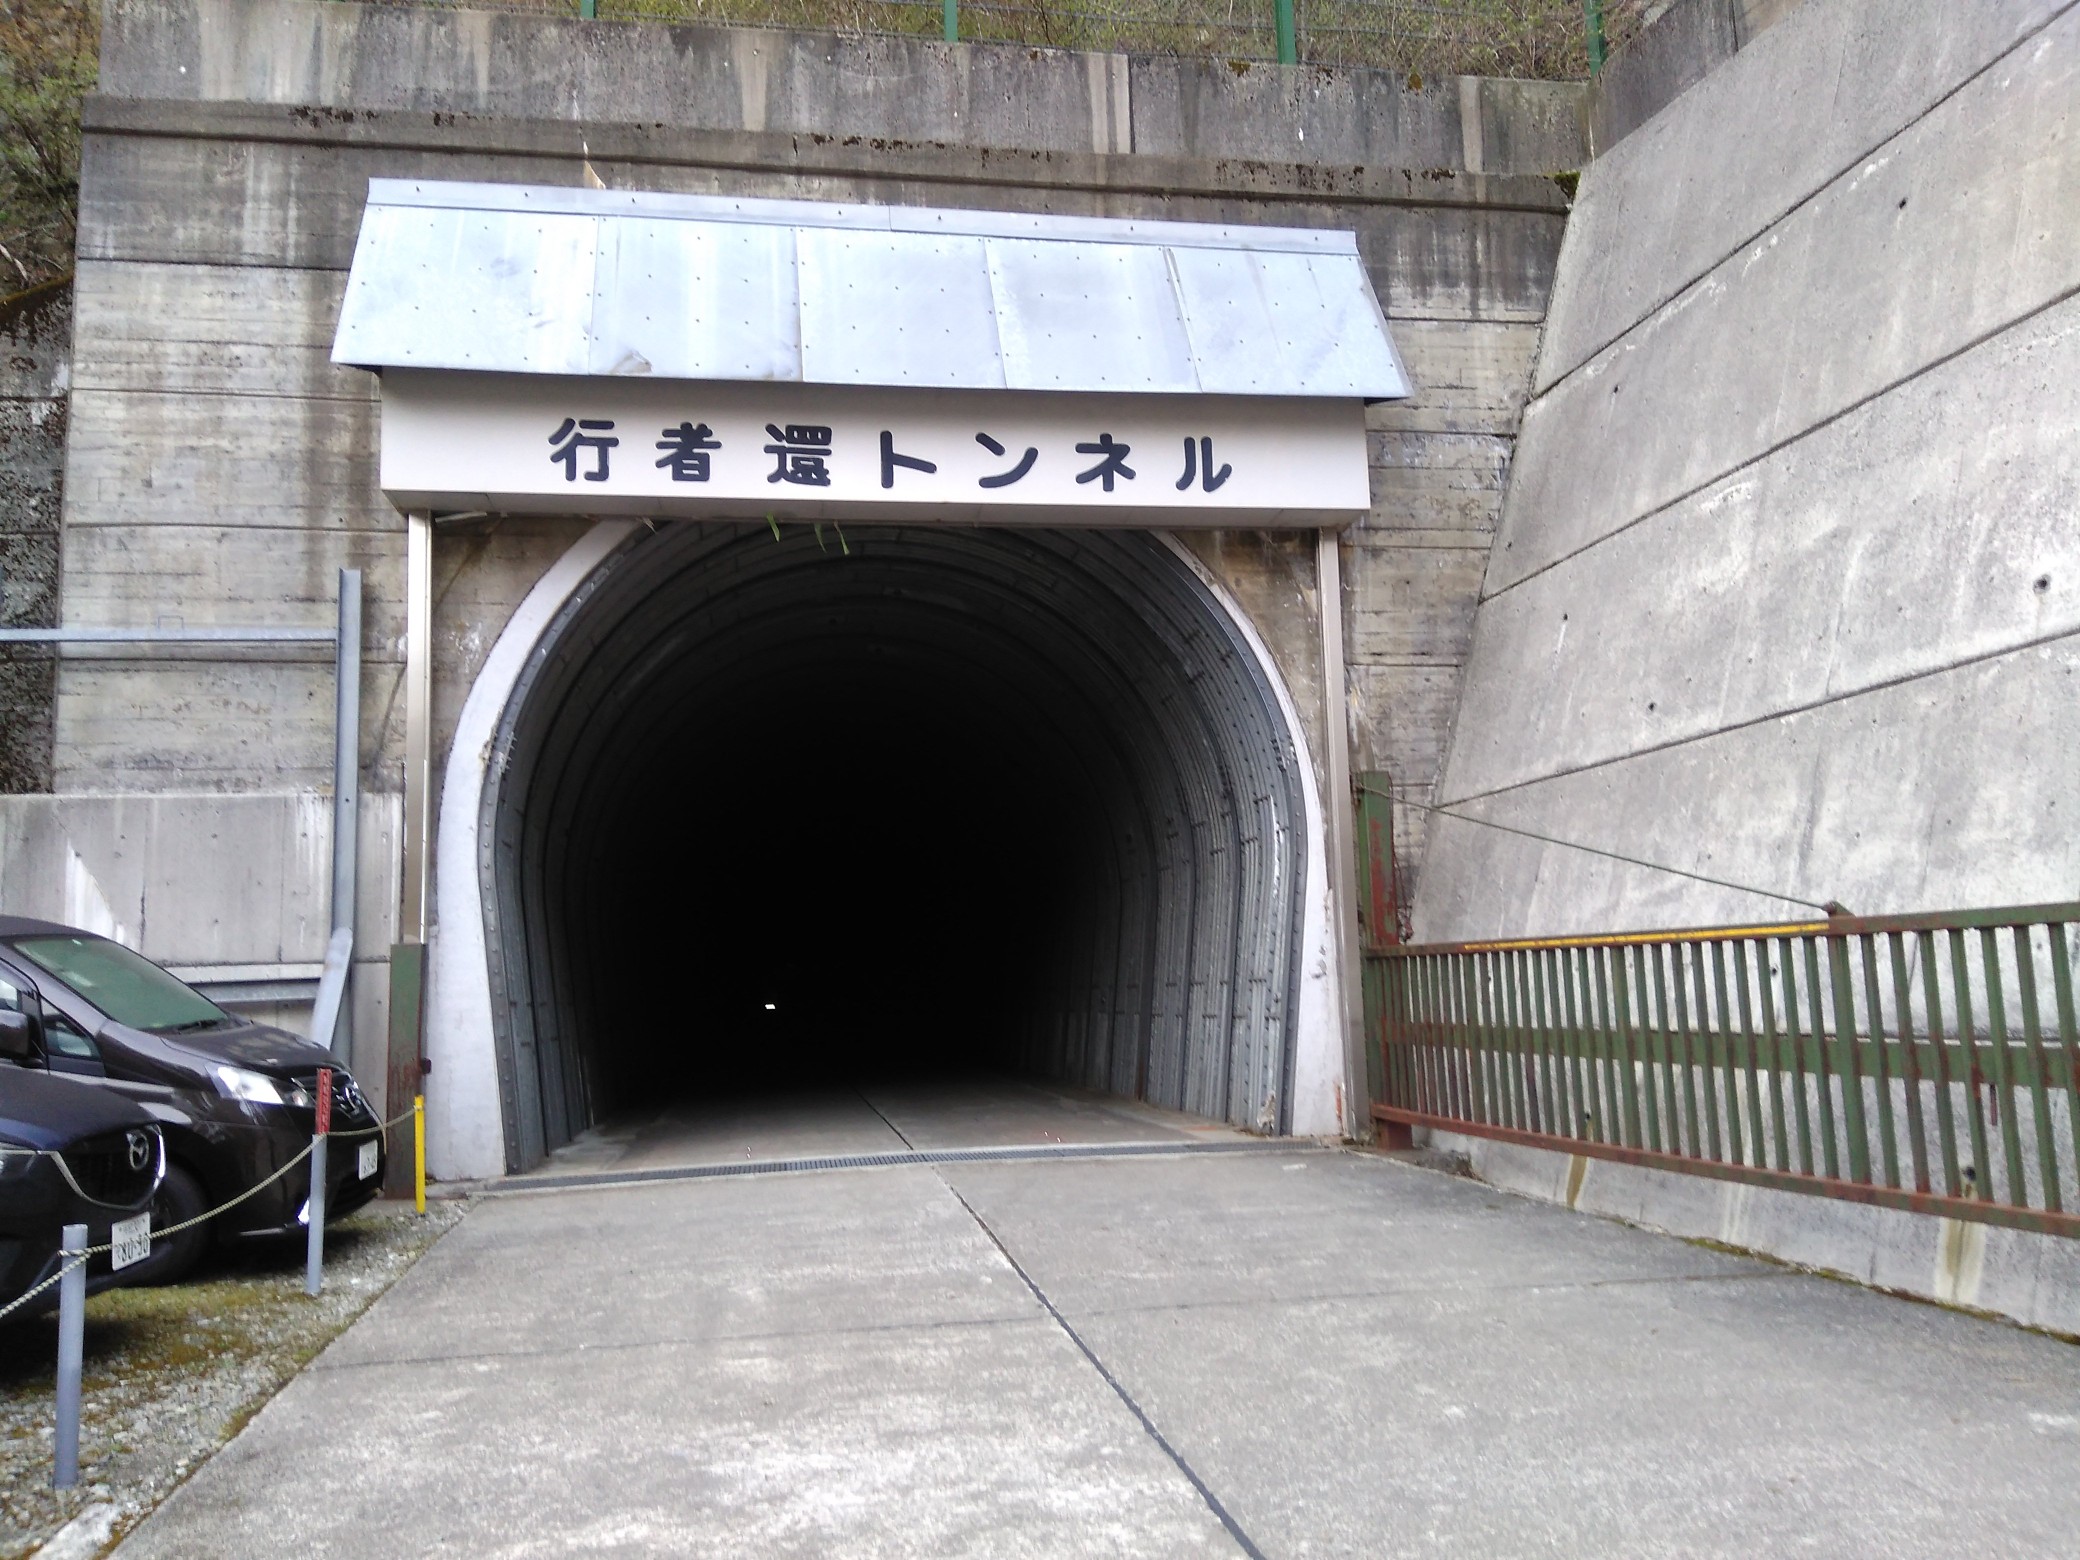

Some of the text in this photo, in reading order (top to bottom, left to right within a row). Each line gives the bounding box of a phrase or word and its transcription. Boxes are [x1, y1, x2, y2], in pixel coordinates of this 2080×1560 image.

[548, 418, 1232, 493] 行者還トンネル
